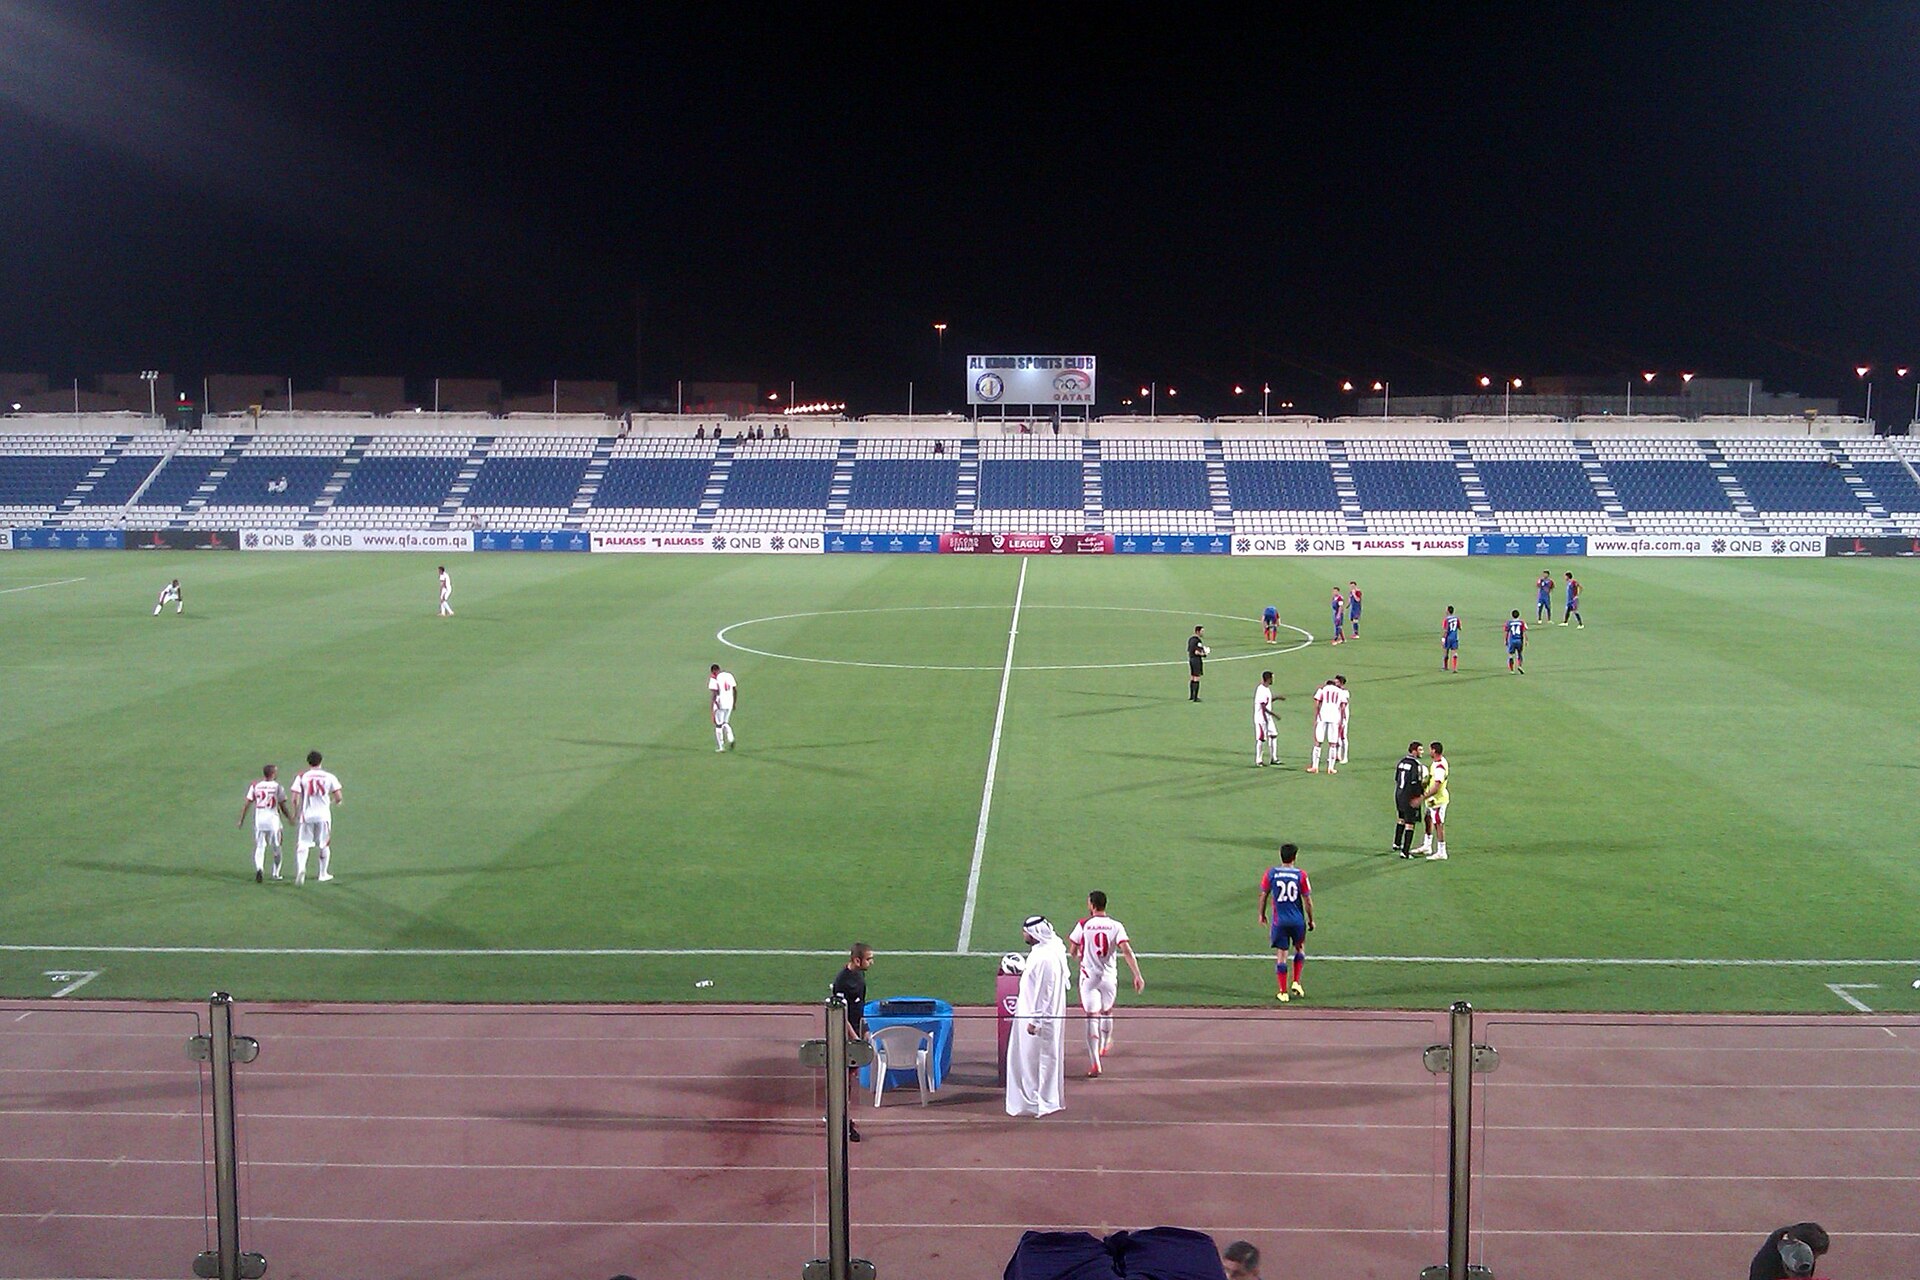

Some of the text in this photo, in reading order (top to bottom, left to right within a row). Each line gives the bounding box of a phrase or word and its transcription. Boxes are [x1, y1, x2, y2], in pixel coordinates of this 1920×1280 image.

[969, 357, 983, 369] AL
[1018, 357, 1062, 370] SPORTS
[1064, 357, 1094, 369] CLUB
[262, 535, 294, 546] QNB
[320, 535, 352, 546] QNB
[363, 534, 467, 548] www.qfa.com.qa
[605, 537, 646, 545] ALKASS
[664, 537, 704, 545] ALKASS
[730, 537, 761, 549] QNB
[788, 537, 820, 549] QNB
[1008, 540, 1046, 548] LEAGUE
[1254, 539, 1286, 551] QNB
[1313, 539, 1345, 551] QNB
[1363, 541, 1405, 549] ALKASS
[1423, 541, 1464, 549] ALKASS
[1594, 539, 1701, 552] www.qfa.com.qa
[1729, 540, 1762, 552] QNB
[1789, 540, 1822, 552] QNB
[1276, 880, 1298, 902] 20
[1093, 932, 1109, 958] 9
